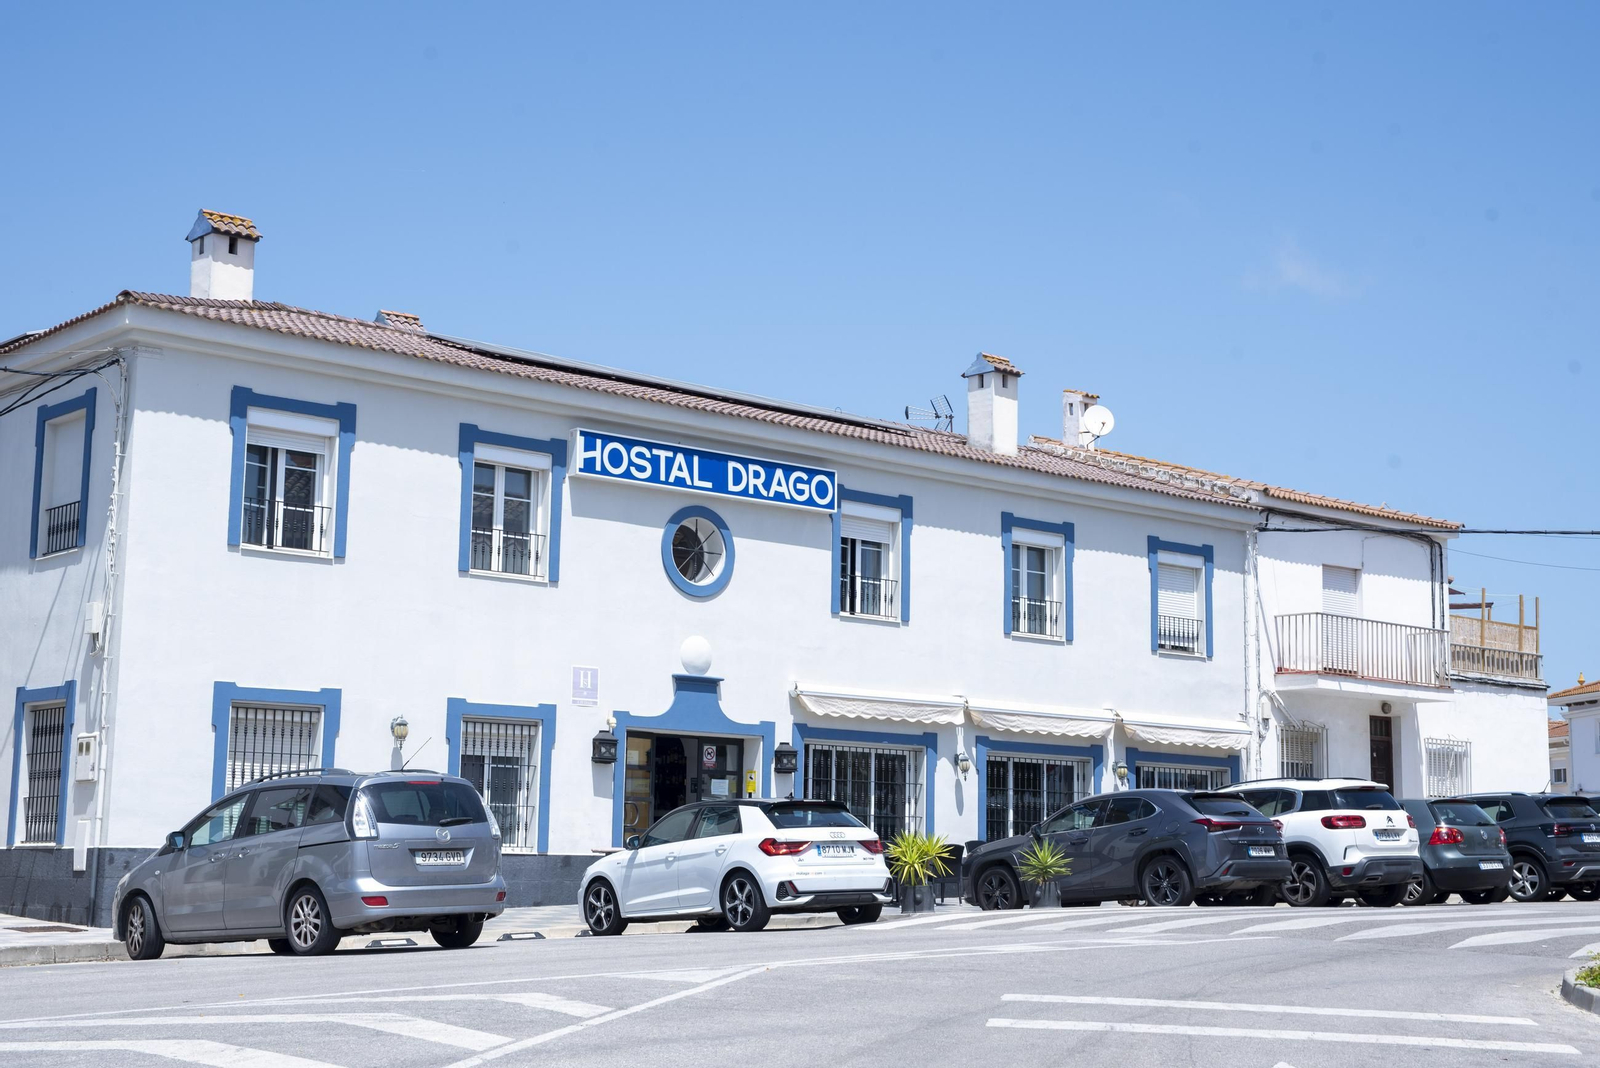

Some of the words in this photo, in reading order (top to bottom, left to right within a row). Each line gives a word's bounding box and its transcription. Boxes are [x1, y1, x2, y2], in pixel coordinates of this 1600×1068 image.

[578, 435, 713, 489] HOSTAL
[727, 460, 834, 506] DRAGO
[821, 845, 841, 854] 8710
[421, 851, 444, 862] 9734
[445, 851, 462, 862] GVD
